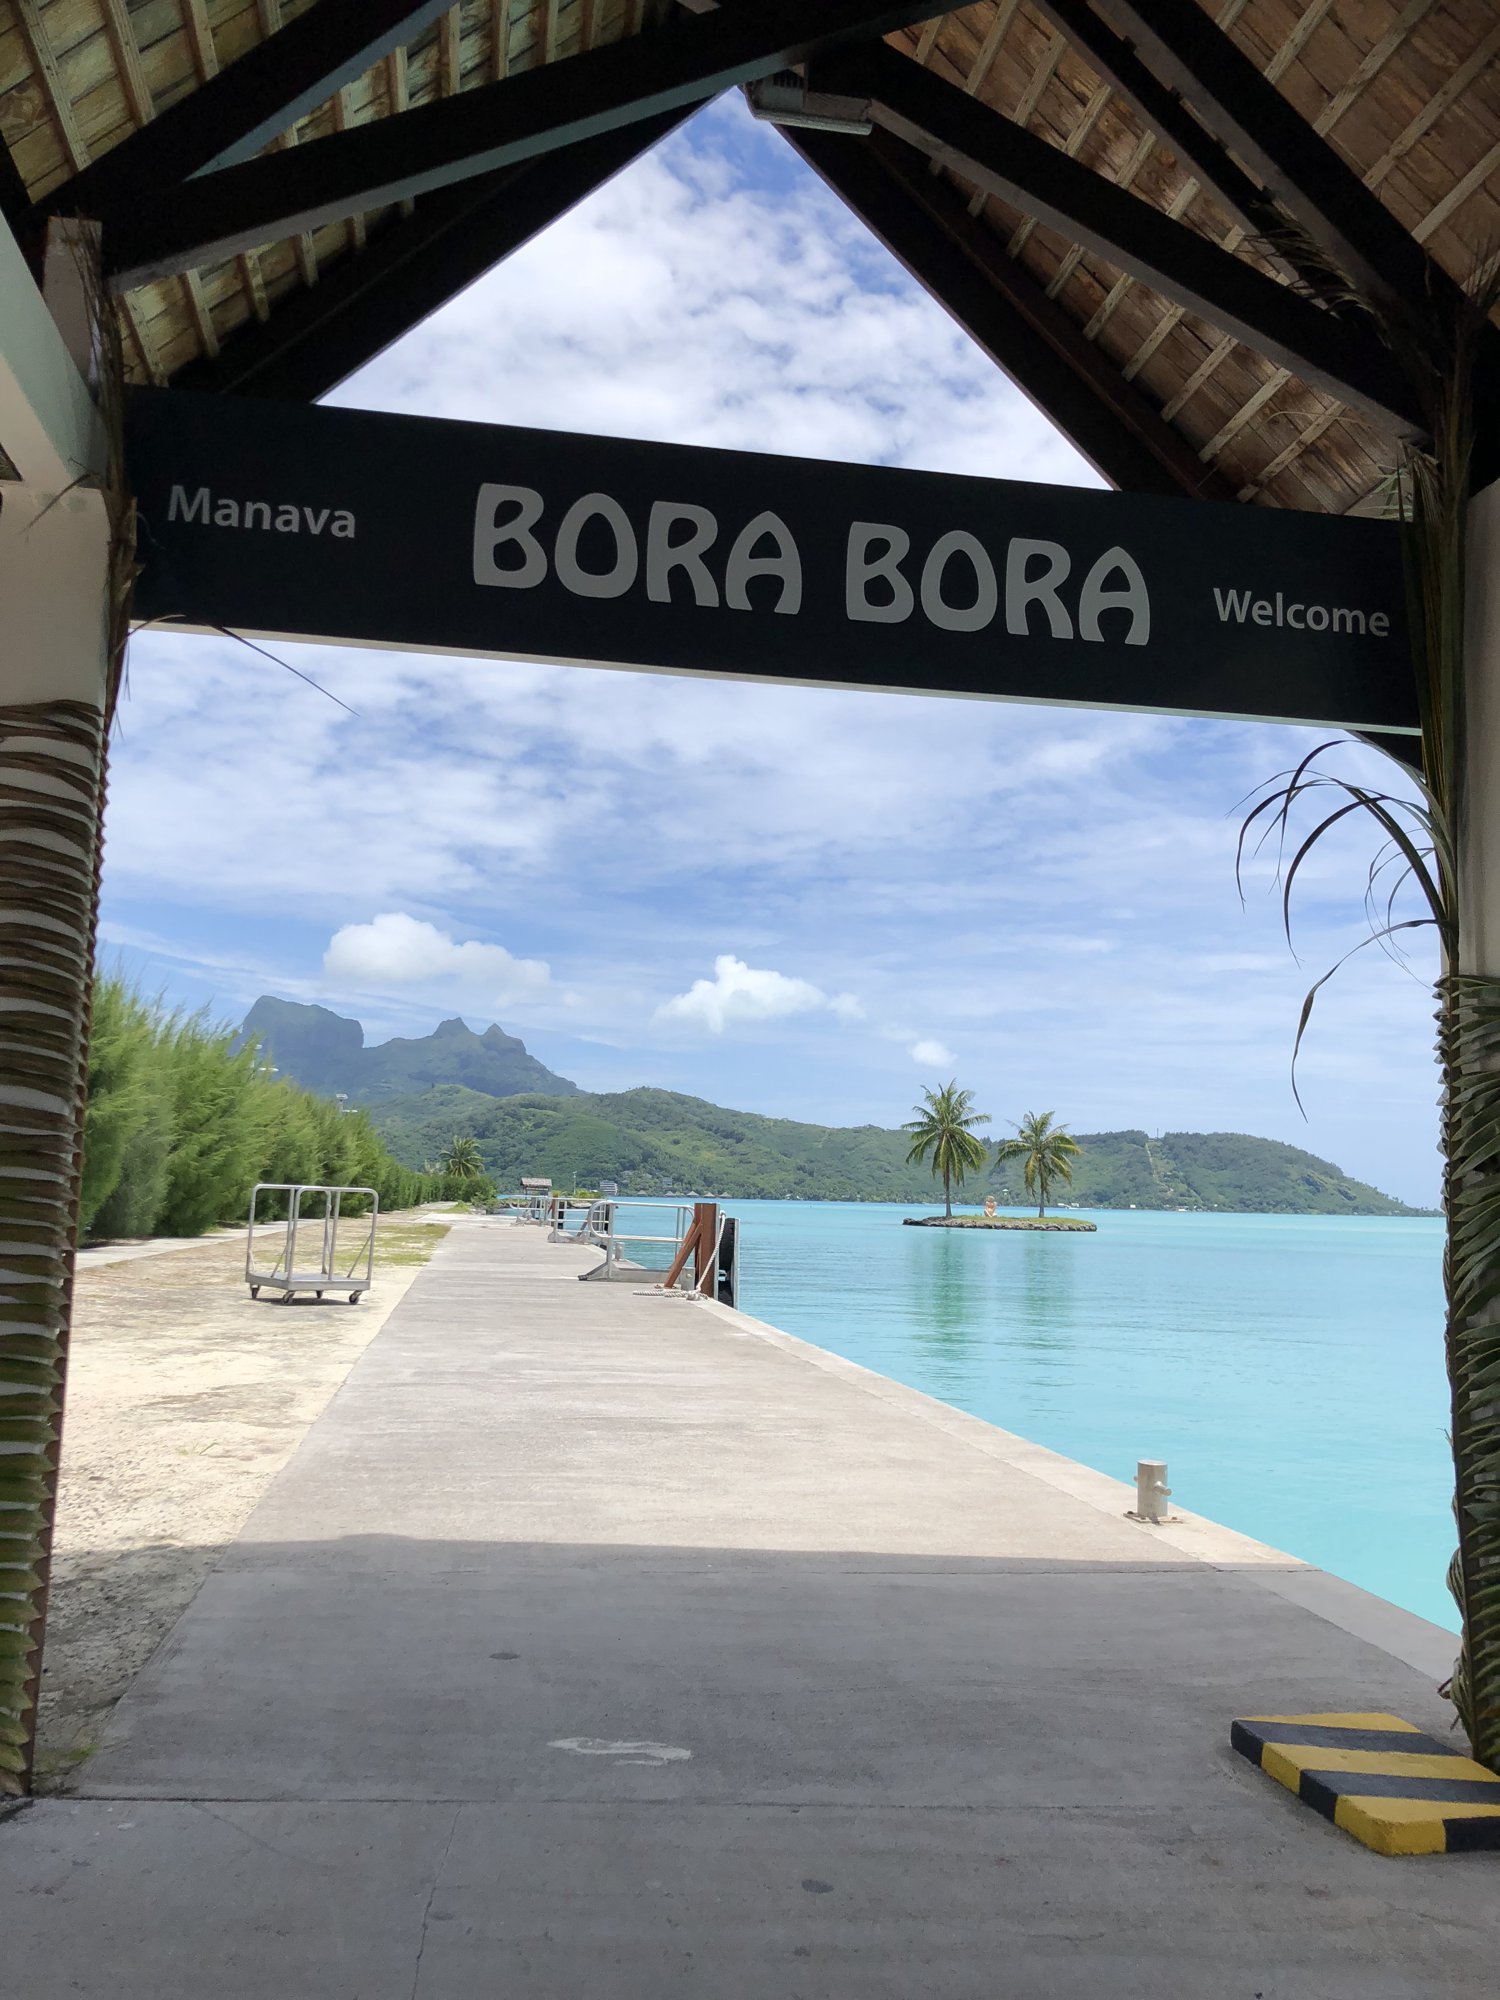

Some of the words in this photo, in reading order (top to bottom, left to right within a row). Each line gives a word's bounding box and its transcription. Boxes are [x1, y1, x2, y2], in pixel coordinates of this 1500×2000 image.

[167, 484, 356, 538] Manava
[473, 483, 802, 615] BORA
[845, 521, 1151, 646] BORA
[1213, 587, 1390, 637] Welcome
